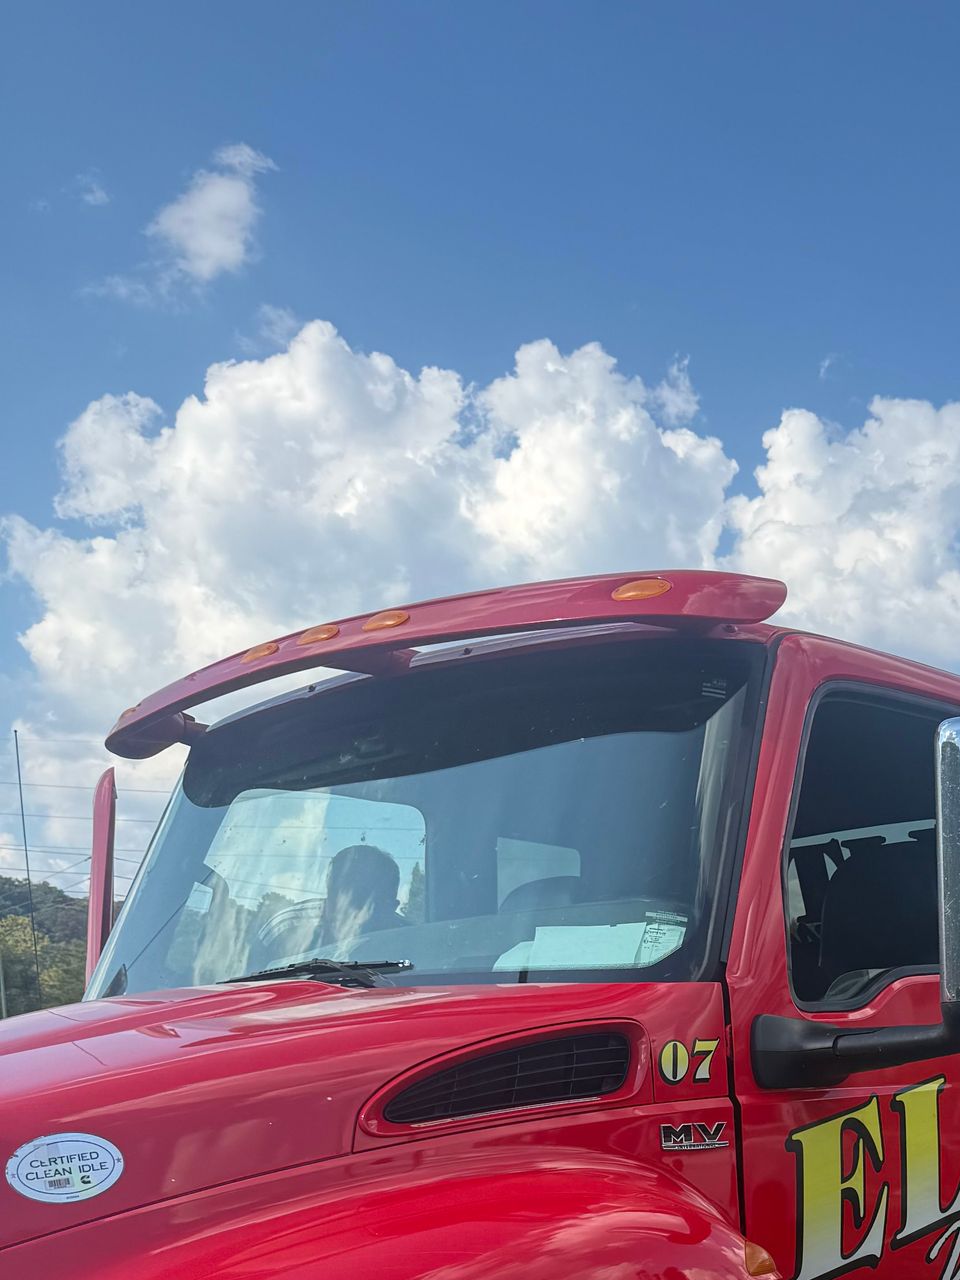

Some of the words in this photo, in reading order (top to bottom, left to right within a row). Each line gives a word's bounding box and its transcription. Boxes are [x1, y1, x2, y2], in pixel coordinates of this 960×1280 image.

[658, 1036, 720, 1087] 07
[660, 1122, 728, 1144] MV
[29, 1151, 99, 1169] CERTIFIED
[25, 1167, 73, 1181] CLEAN
[78, 1161, 109, 1174] IDLE
